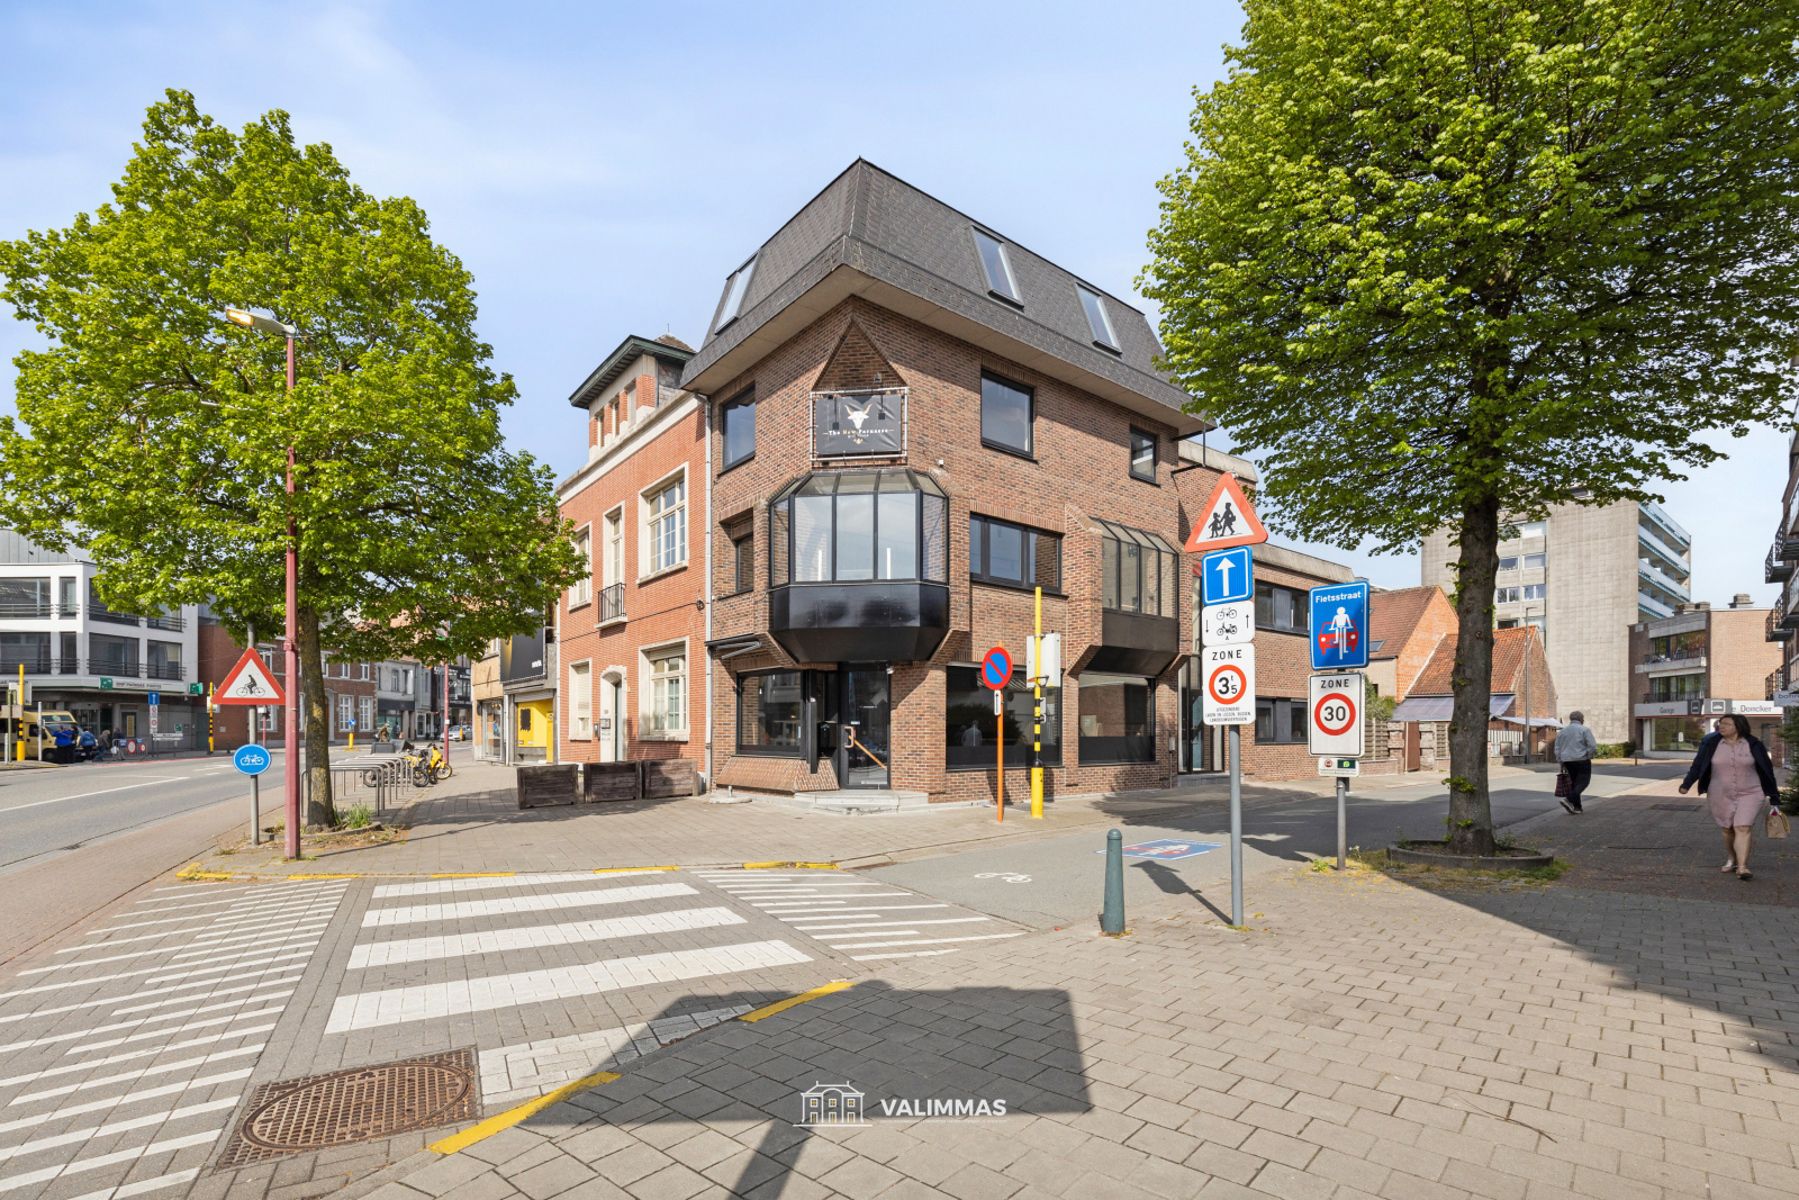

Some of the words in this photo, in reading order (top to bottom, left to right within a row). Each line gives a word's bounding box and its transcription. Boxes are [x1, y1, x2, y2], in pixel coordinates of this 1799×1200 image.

[1315, 591, 1362, 604] Fietsstraat
[1212, 649, 1242, 661] ZONE
[1320, 678, 1350, 689] ZONE
[1324, 706, 1346, 721] 30
